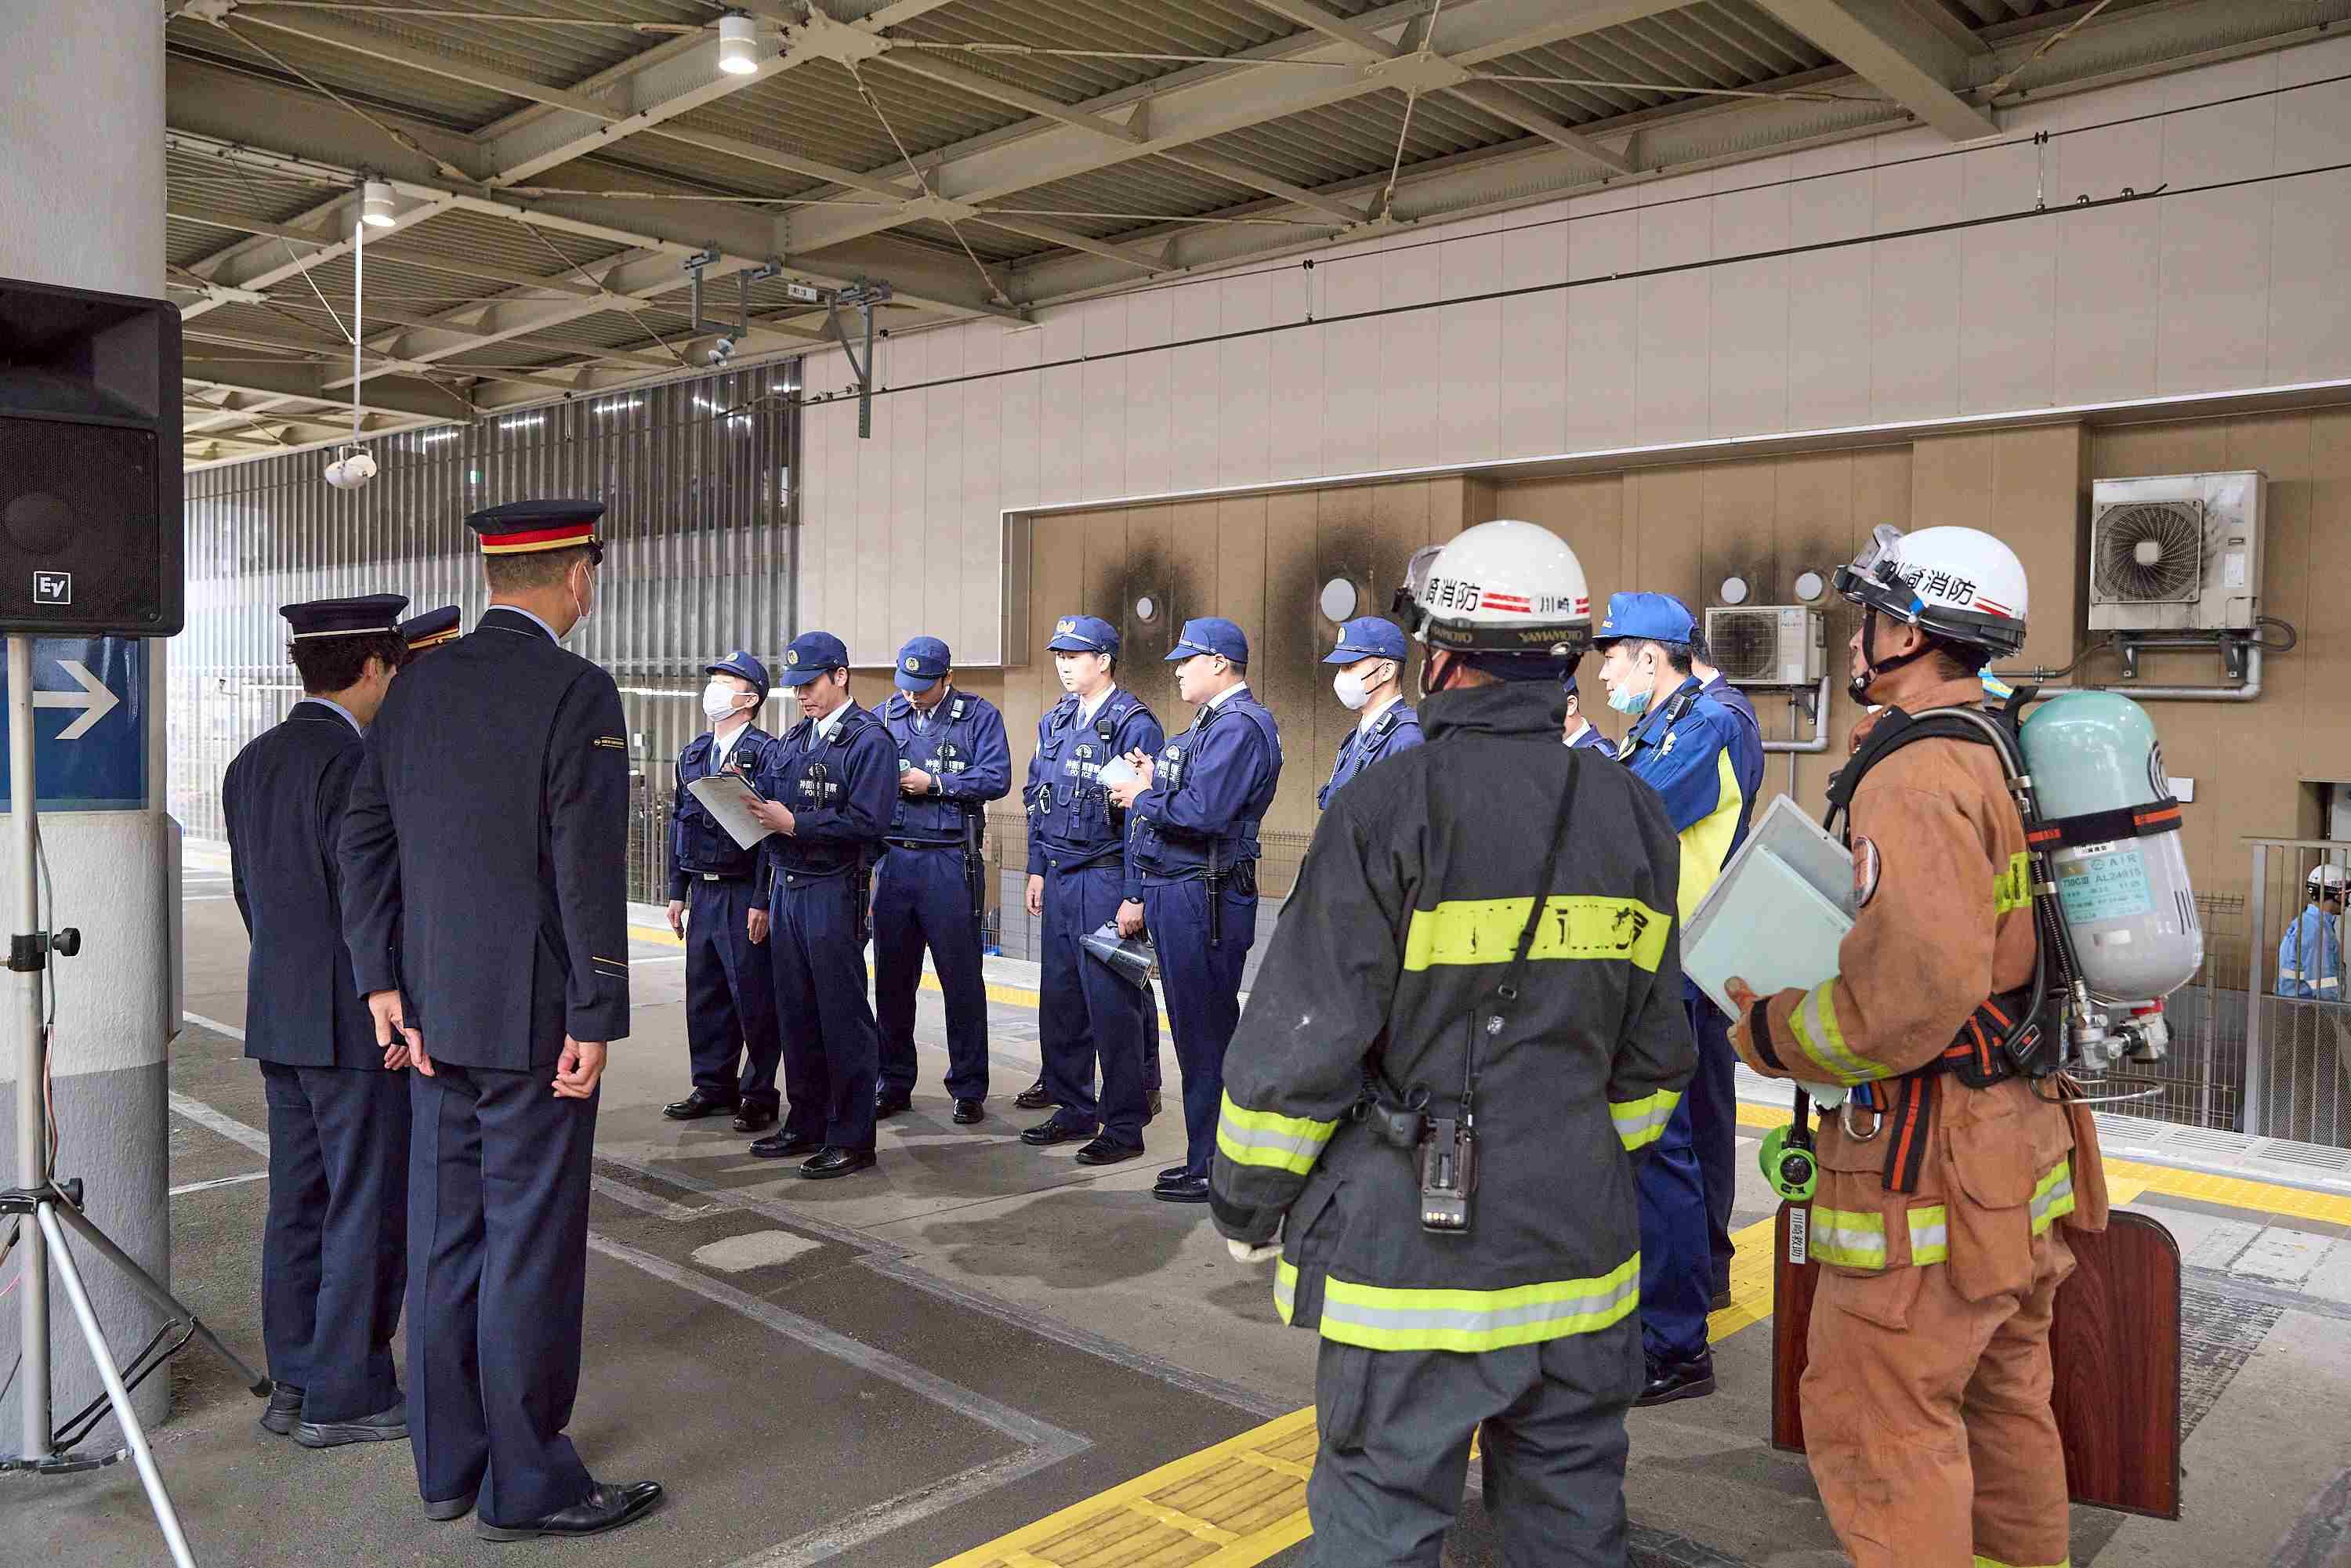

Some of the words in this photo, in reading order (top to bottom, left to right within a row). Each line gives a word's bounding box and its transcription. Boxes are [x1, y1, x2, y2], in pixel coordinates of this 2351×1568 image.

[40, 576, 66, 598] EV
[1540, 596, 1570, 613] 川崎
[1518, 630, 1584, 642] YAMAMOTO
